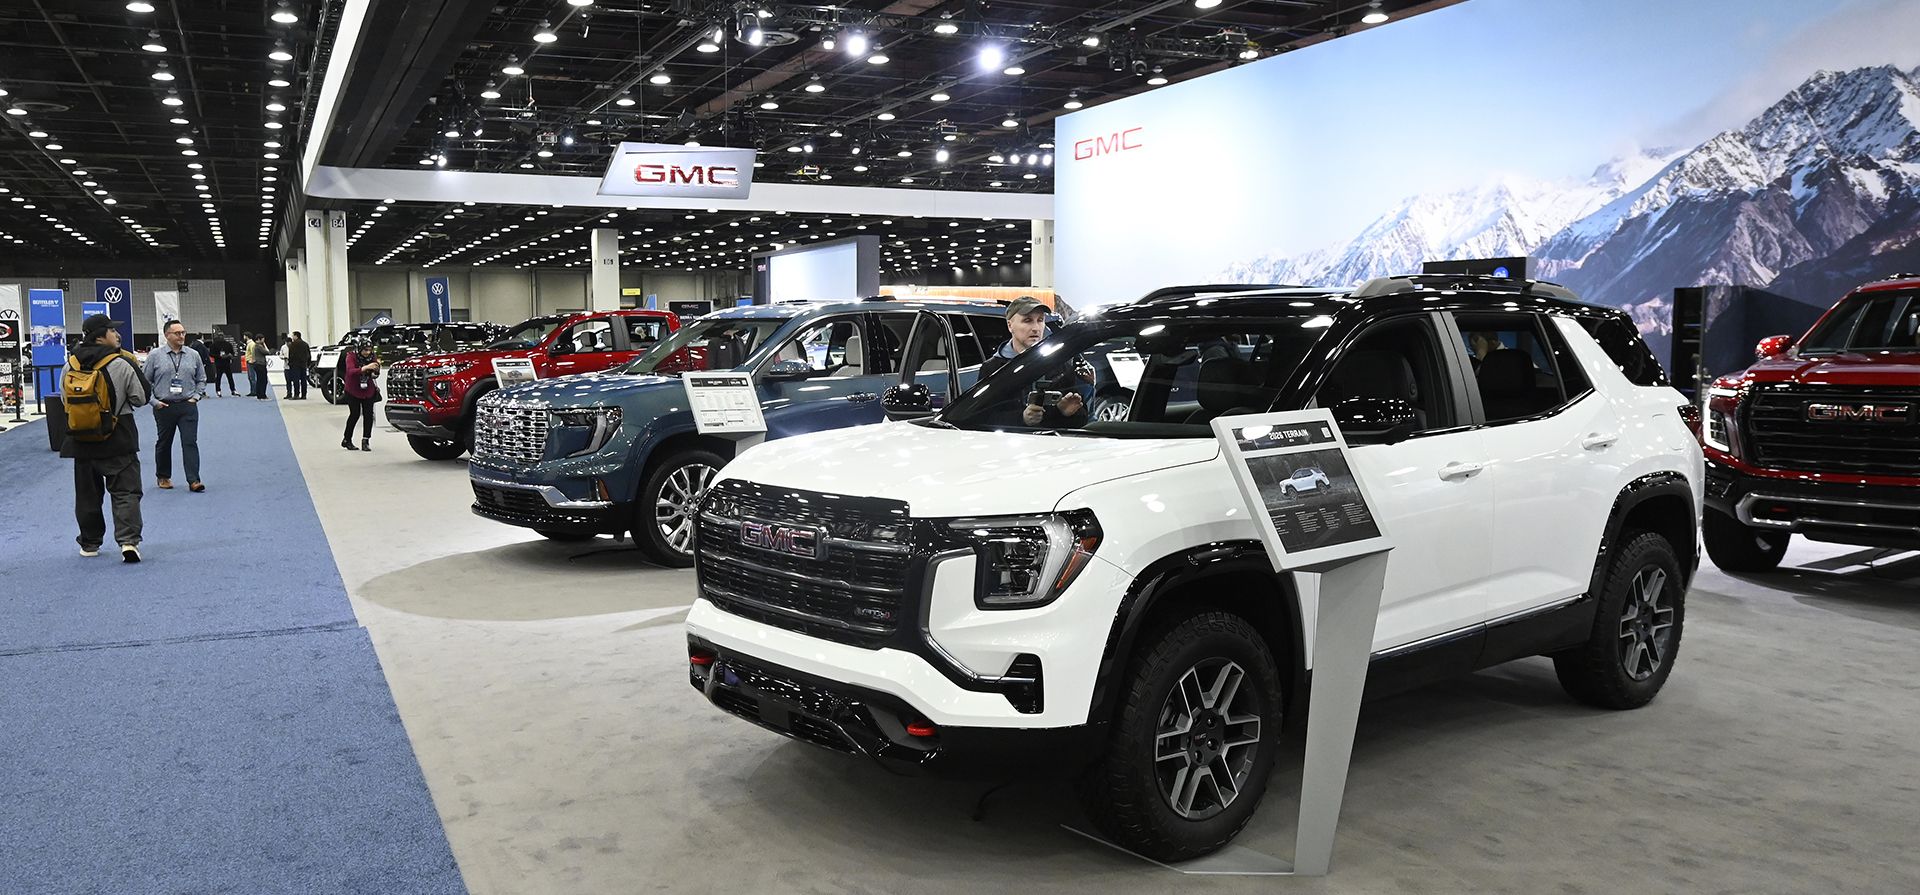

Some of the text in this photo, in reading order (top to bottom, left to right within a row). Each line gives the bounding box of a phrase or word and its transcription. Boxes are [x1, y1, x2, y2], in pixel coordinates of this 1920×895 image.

[1075, 127, 1142, 160] GMC
[634, 164, 738, 187] GMC
[309, 219, 320, 227] C4
[332, 219, 344, 228] B4
[1808, 403, 1908, 422] GMC
[1283, 429, 1309, 439] TERRAIN
[740, 521, 816, 557] GMC
